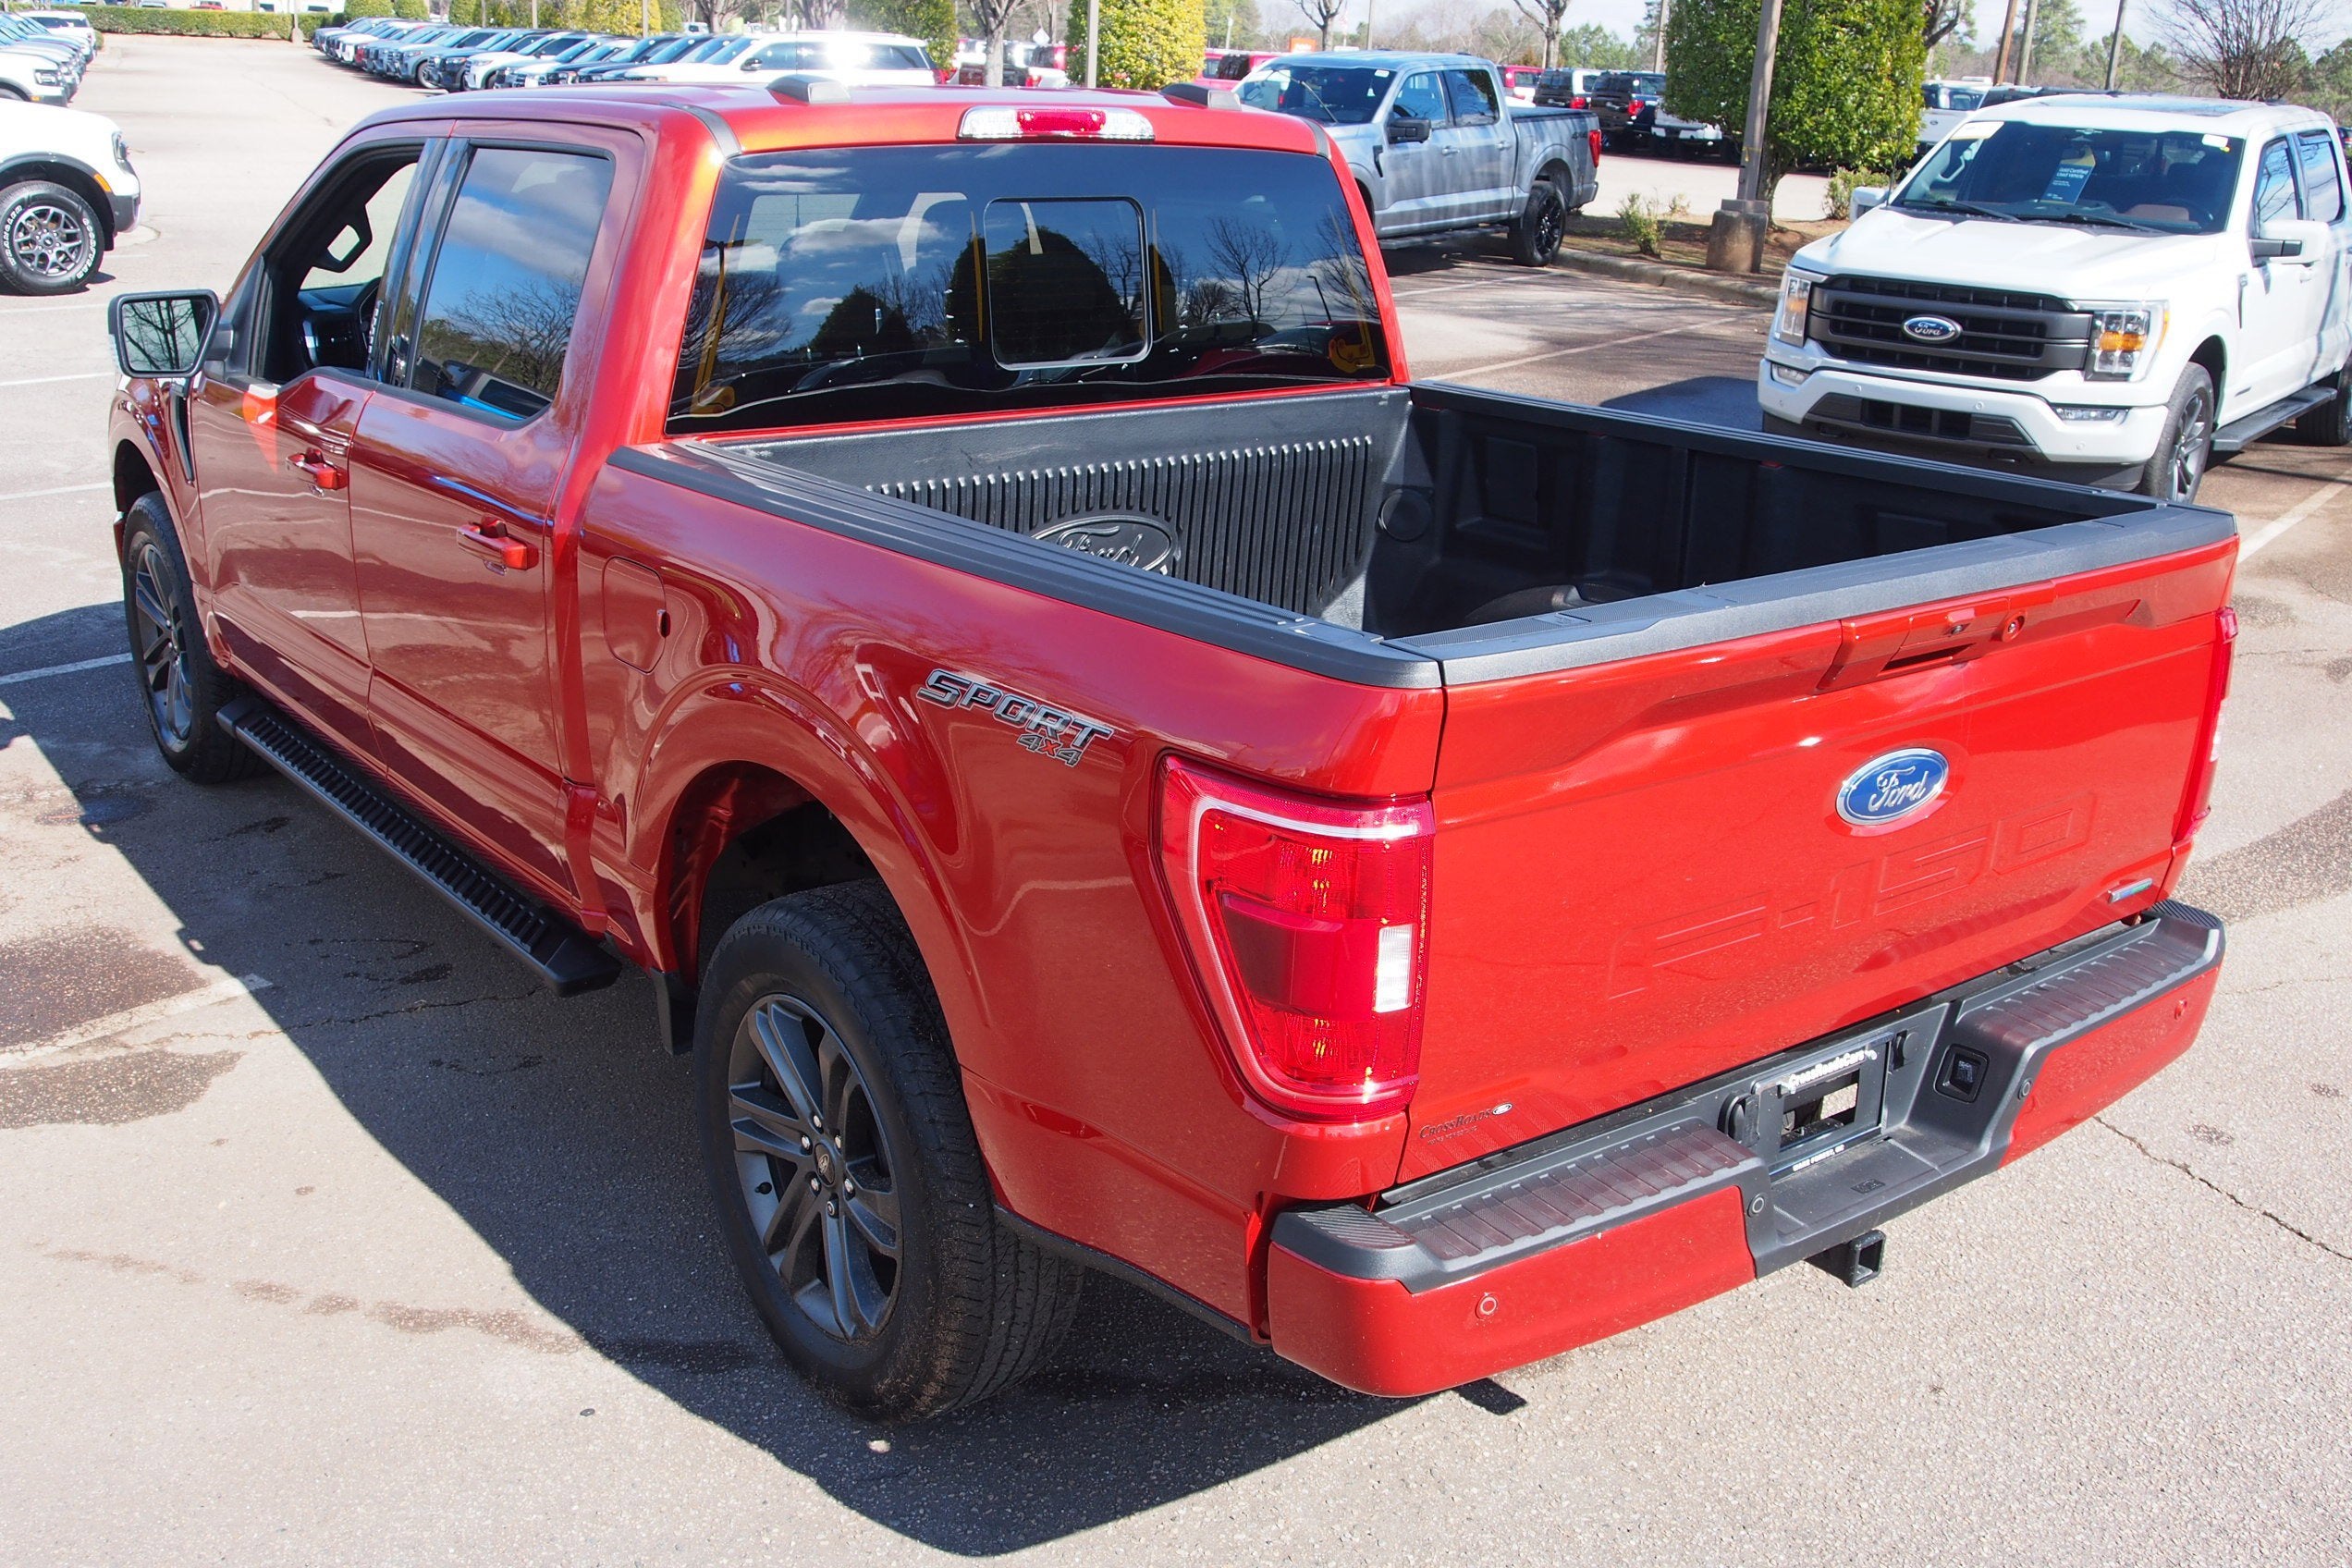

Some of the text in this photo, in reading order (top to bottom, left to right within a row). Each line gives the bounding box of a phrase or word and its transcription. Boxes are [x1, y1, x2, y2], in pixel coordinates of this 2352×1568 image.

[76, 217, 97, 279] GOODYEAR
[1914, 321, 1944, 336] Ford
[916, 668, 1114, 750] SPORT
[1868, 766, 1930, 813] Ford
